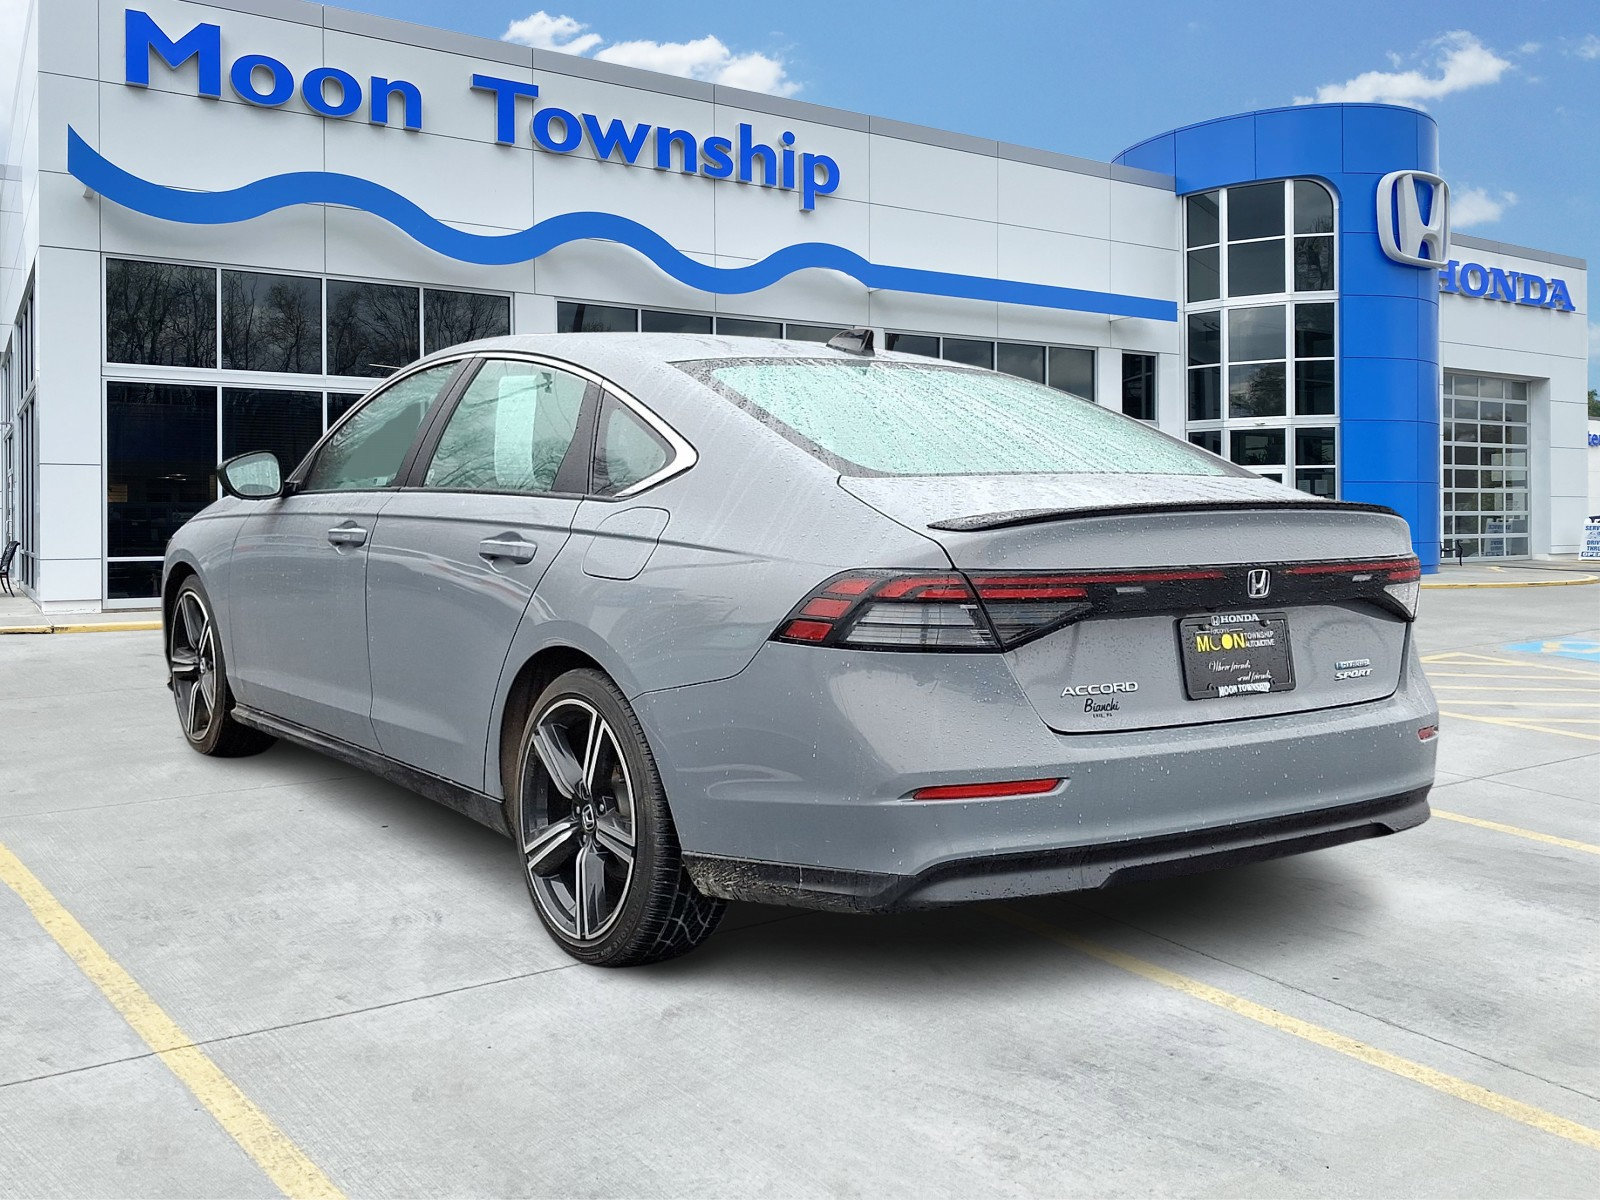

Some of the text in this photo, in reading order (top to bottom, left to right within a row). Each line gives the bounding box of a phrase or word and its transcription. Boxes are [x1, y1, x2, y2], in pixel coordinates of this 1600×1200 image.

[125, 8, 841, 212] Moon Township
[1438, 259, 1575, 312] HONDA
[1220, 613, 1260, 624] HONDA
[1244, 630, 1274, 640] TOWNSHIP
[1246, 638, 1275, 648] AUTOMOTIVE
[1334, 668, 1373, 681] SPORT
[1061, 682, 1138, 697] ACCORD
[1218, 681, 1270, 698] MOON TOWNSHIP
[1084, 697, 1120, 713] Bianchi
